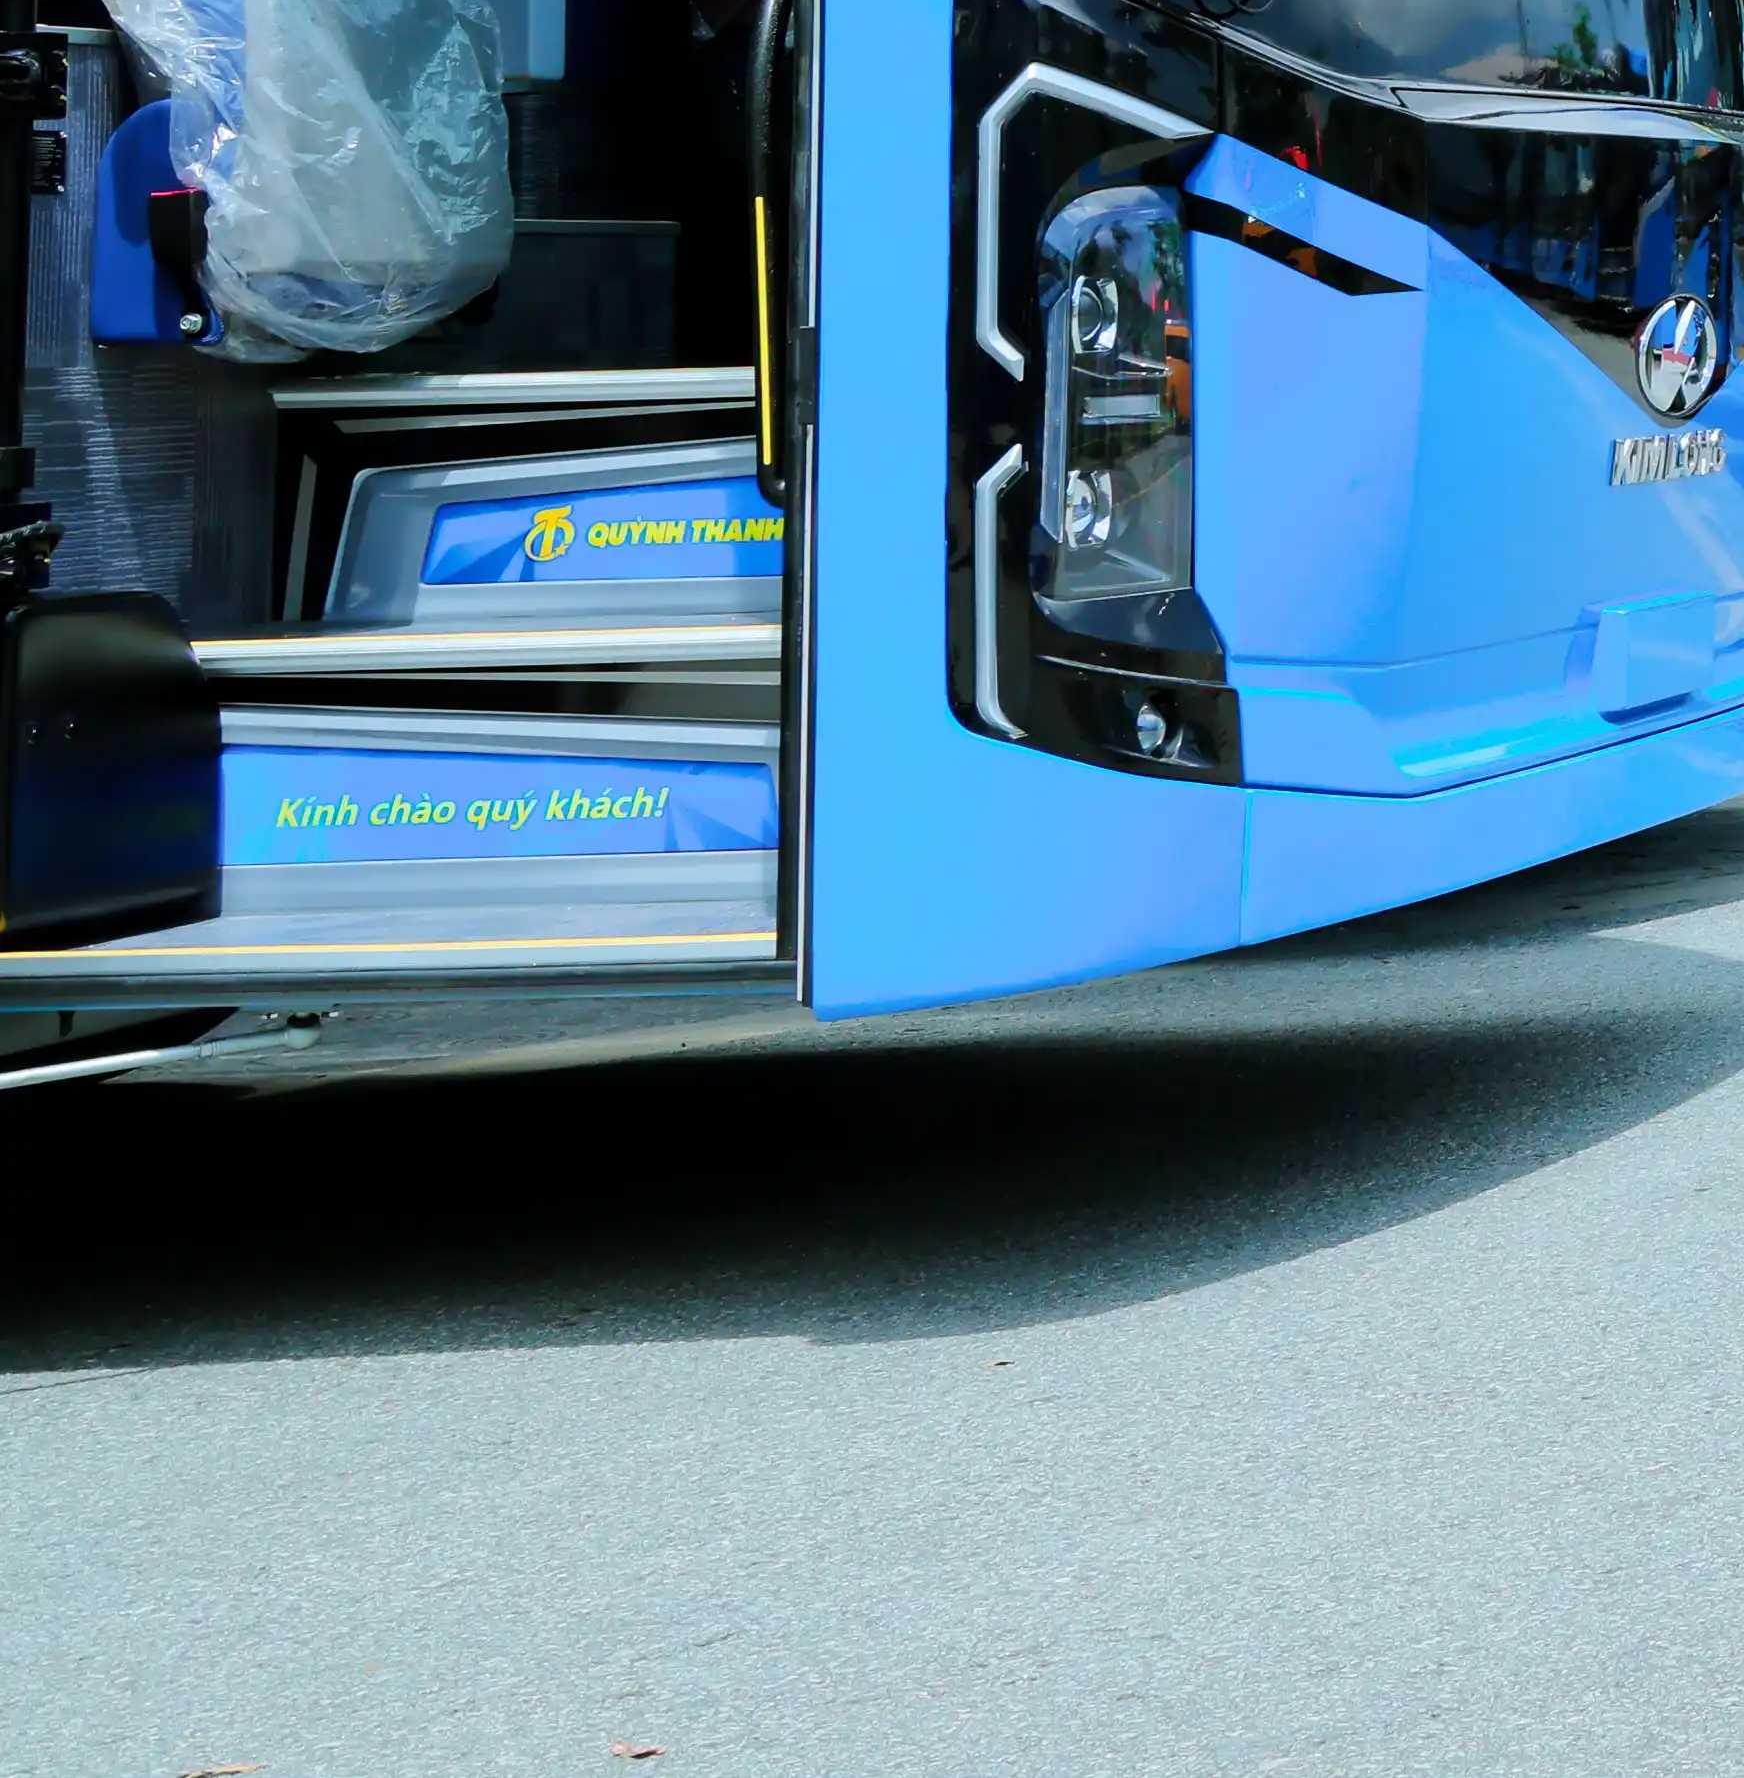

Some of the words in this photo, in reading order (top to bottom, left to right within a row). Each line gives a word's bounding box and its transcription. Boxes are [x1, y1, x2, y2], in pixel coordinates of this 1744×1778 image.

[1610, 435, 1667, 486] KIM
[587, 515, 686, 550] QUỲNH
[691, 516, 784, 544] THANH
[276, 794, 360, 828] Kính
[369, 792, 456, 826] chào
[466, 789, 539, 832] quý
[545, 785, 670, 822] khách!
